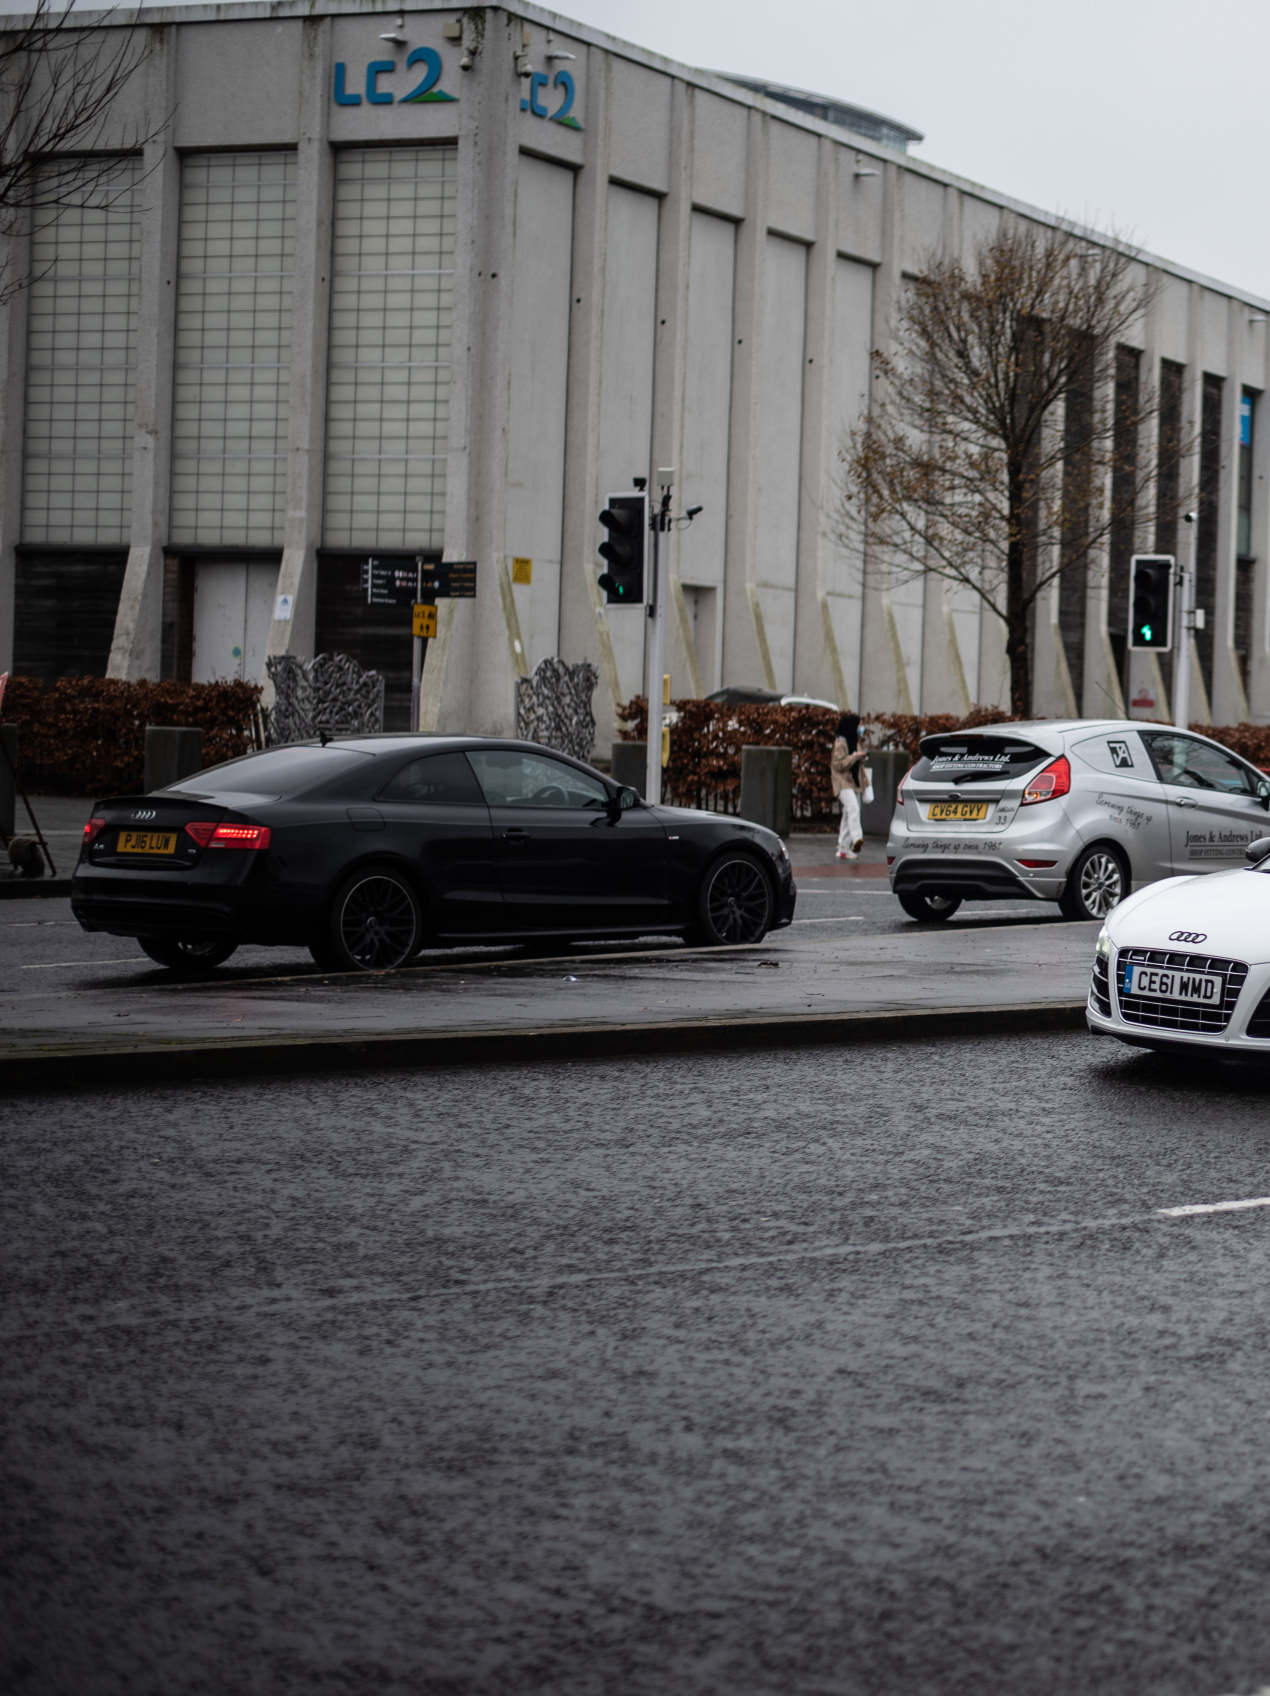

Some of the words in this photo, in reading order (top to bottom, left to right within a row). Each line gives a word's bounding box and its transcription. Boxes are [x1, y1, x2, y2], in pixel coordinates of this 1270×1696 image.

[334, 46, 459, 105] LC2
[520, 70, 583, 129] C2
[930, 755, 952, 765] Jones
[953, 754, 960, 762] &
[961, 753, 994, 761] Andrews
[931, 804, 959, 817] CV64
[961, 804, 984, 817] GVY
[1095, 793, 1124, 816] Screwing
[1127, 805, 1145, 820] things
[1145, 814, 1153, 826] up
[995, 816, 1007, 825] 33
[1109, 813, 1123, 824] since
[1125, 818, 1141, 831] 1961
[124, 834, 147, 849] PJ16
[149, 835, 171, 850] LUW
[903, 837, 929, 853] Screwing
[932, 838, 951, 853] things
[953, 843, 960, 853] up
[963, 842, 979, 850] since
[982, 841, 1002, 851] 1961
[1184, 830, 1206, 847] Jones
[1208, 830, 1216, 843] &
[1216, 830, 1249, 843] Andrews
[1137, 970, 1175, 995] CE61
[1179, 975, 1215, 1000] WMD
